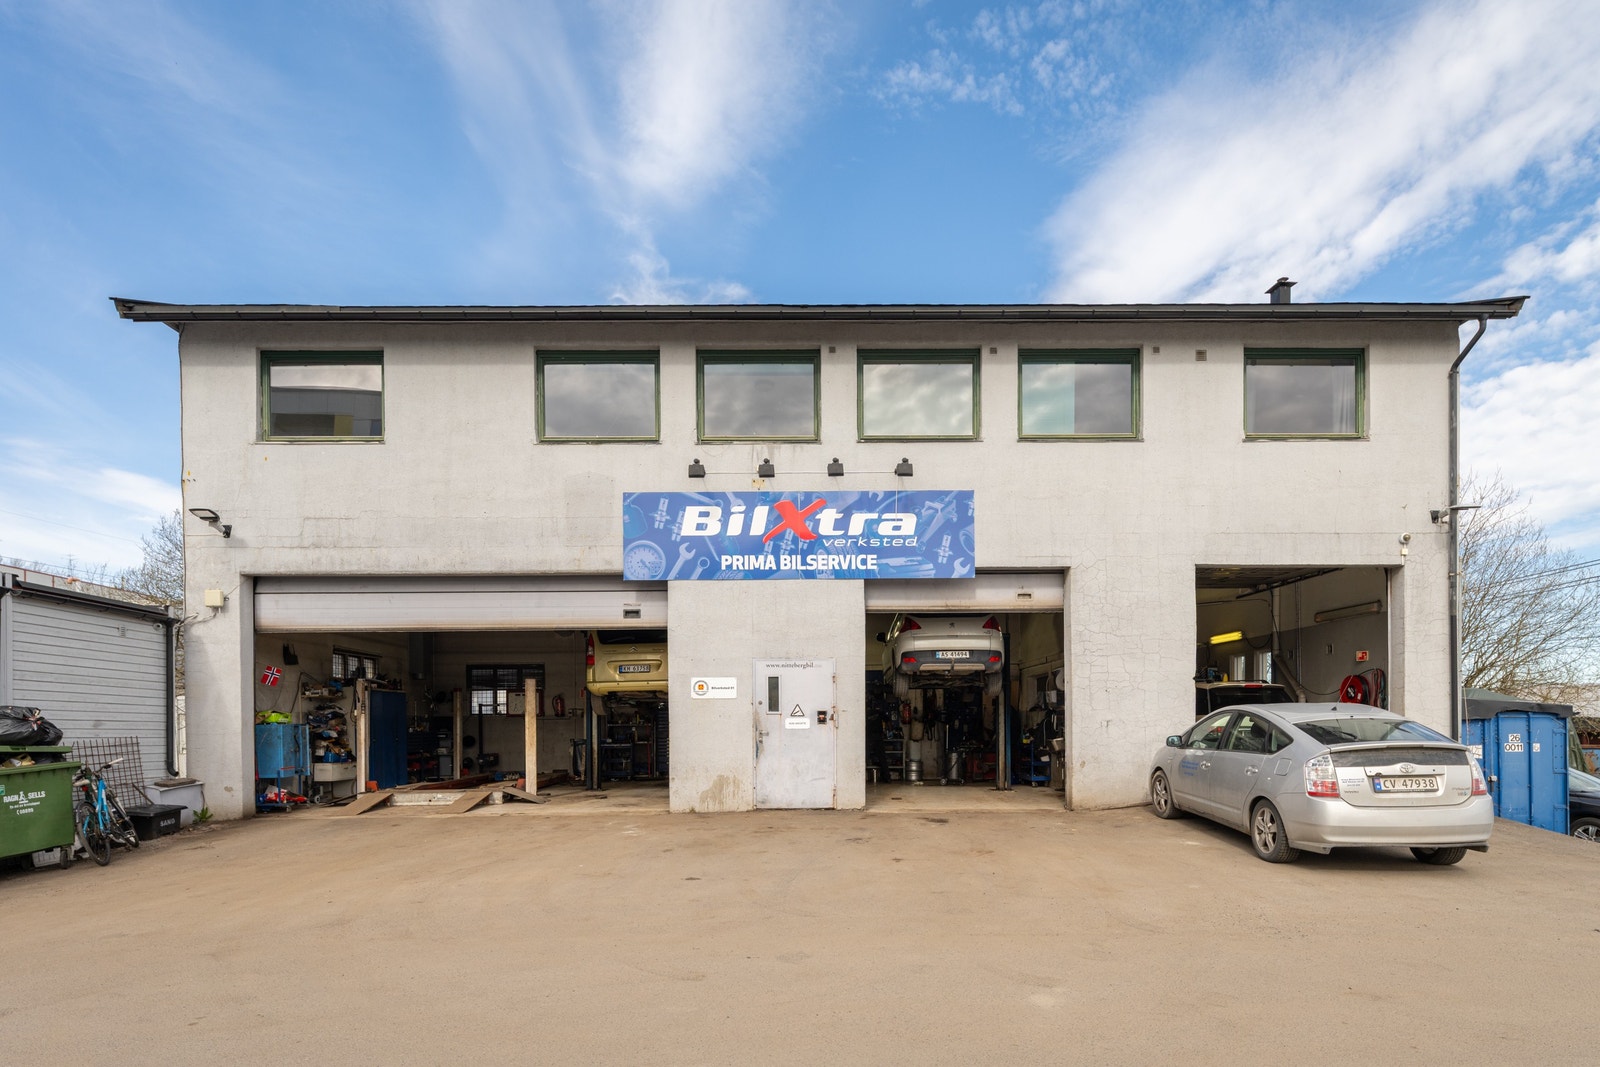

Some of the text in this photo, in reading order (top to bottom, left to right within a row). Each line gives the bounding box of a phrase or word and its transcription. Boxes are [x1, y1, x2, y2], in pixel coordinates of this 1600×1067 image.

[681, 498, 918, 544] BilXtra
[823, 535, 918, 548] verksted
[721, 554, 878, 570] PRIMA BILSERVICE
[1510, 734, 1521, 742] 26
[1504, 743, 1523, 751] 0011
[1383, 778, 1435, 789] CV 47938
[27, 790, 46, 800] SELLS
